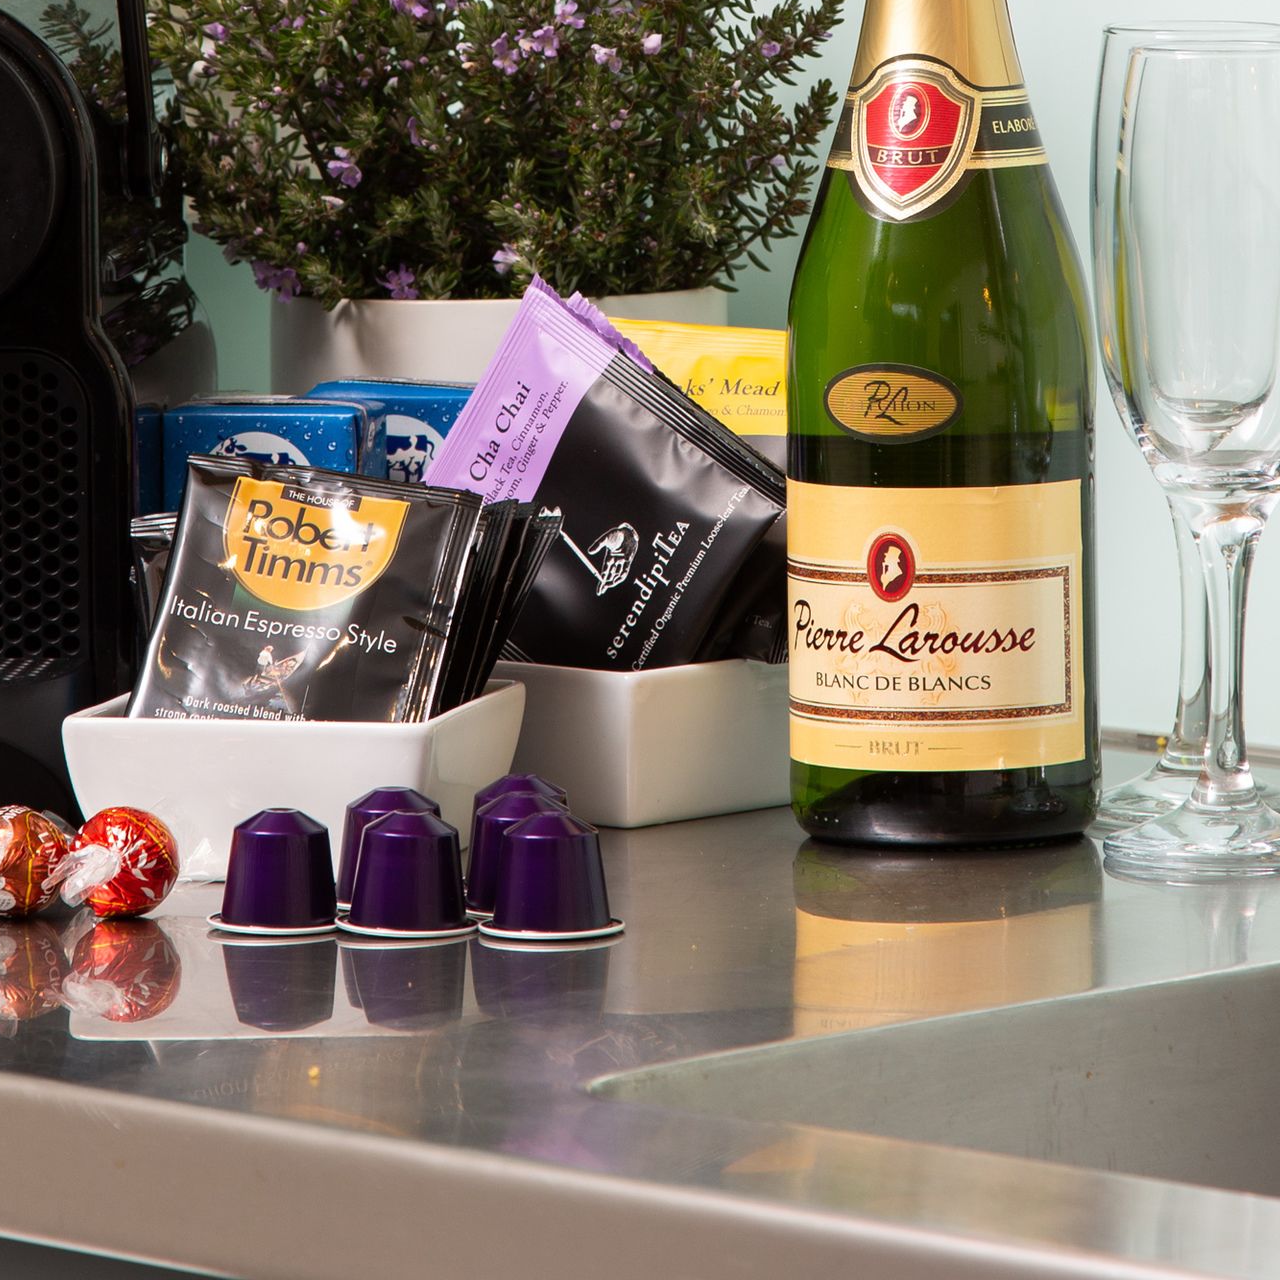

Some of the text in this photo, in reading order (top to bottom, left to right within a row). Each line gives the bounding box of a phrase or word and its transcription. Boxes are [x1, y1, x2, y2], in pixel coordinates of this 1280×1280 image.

[876, 149, 939, 165] BRUT
[720, 378, 782, 397] Mead
[469, 380, 532, 482] Cha Chai
[511, 391, 549, 452] Cinnamon,
[516, 435, 539, 473] Ginger
[542, 380, 569, 420] Pepper.
[288, 490, 306, 502] THE
[243, 499, 376, 552] Robet
[242, 535, 363, 588] Timms
[170, 595, 398, 654] Italian Espresso Style
[631, 629, 659, 671] Certified
[654, 592, 681, 631] Organic
[676, 549, 707, 594] Premium
[793, 599, 1036, 663] Pierre Larousse
[185, 695, 210, 710] Dark
[213, 702, 251, 717] roasted
[253, 706, 282, 721] blend
[815, 671, 992, 692] BLANC DE BLANCS
[154, 706, 187, 720] strong
[869, 740, 924, 756] BRUT
